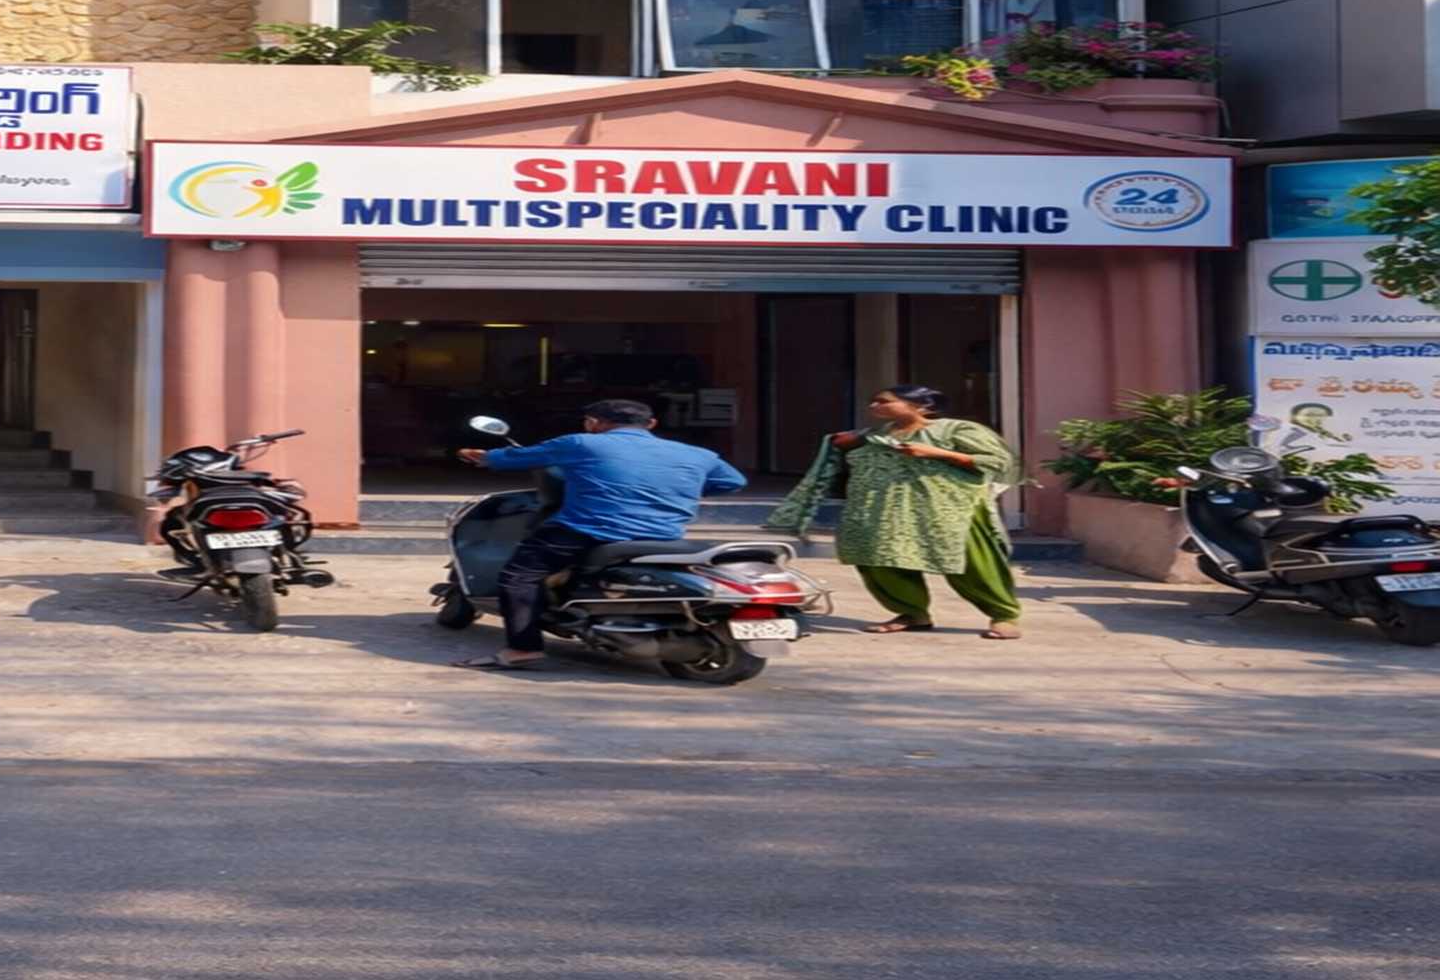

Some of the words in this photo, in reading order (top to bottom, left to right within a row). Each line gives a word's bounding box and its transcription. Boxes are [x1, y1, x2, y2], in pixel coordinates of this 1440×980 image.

[514, 157, 890, 197] SRAVANI
[1114, 188, 1179, 205] 24
[342, 198, 865, 233] MULTISPECIALITY
[885, 204, 1069, 234] CLINIC
